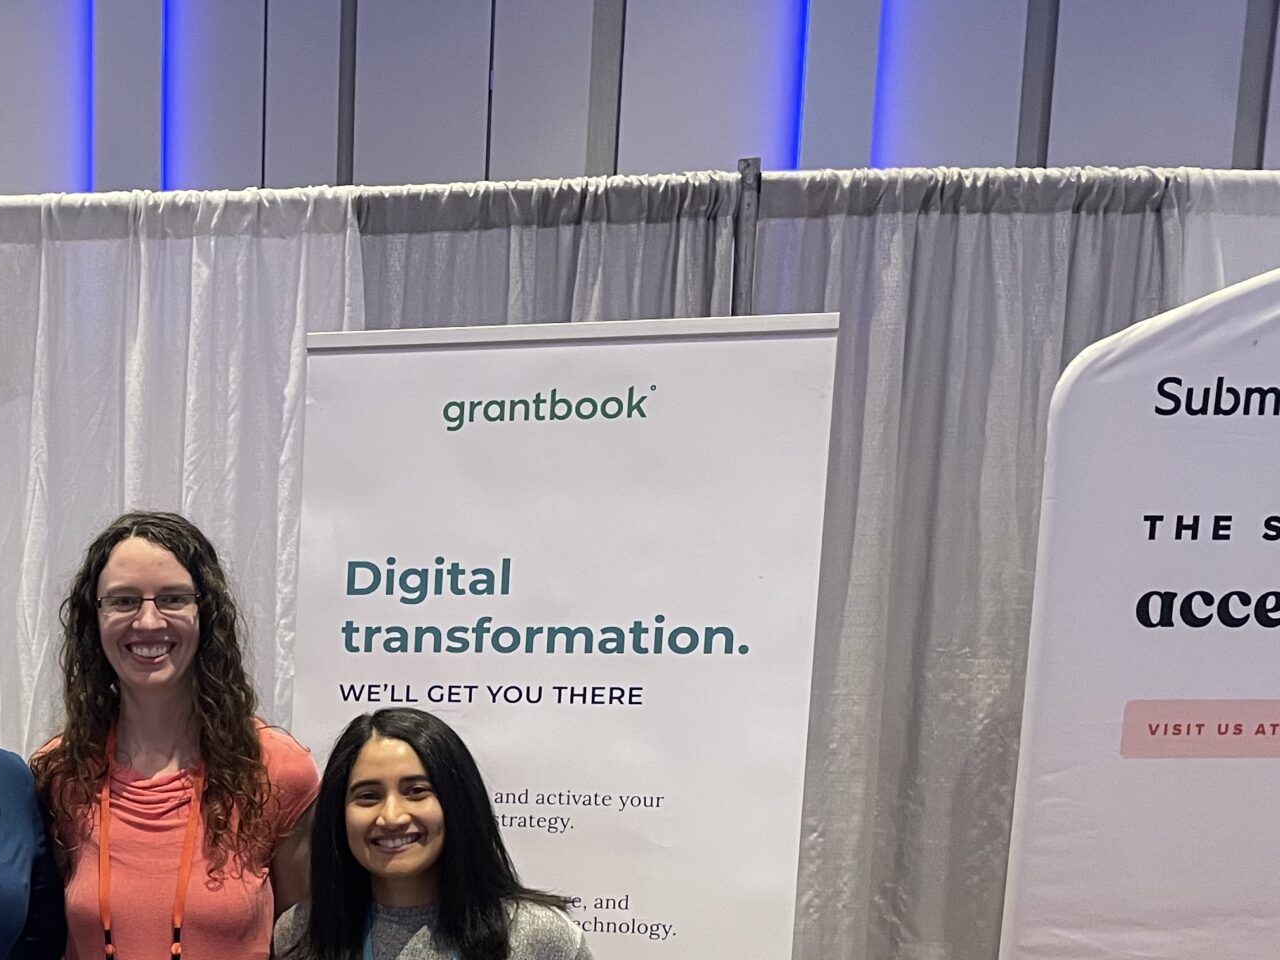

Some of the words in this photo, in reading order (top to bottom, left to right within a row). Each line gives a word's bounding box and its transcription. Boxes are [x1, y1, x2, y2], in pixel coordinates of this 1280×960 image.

[1143, 514, 1233, 540] THE
[346, 556, 512, 605] Digital
[342, 615, 751, 655] transformation.
[339, 683, 419, 703] WE'LL
[427, 684, 479, 704] GET
[487, 685, 543, 705] YOU
[553, 686, 644, 705] THERE
[1148, 723, 1205, 736] VISIT
[1217, 723, 1243, 736] US
[1254, 723, 1280, 736] AT
[494, 789, 529, 805] and
[535, 790, 612, 807] activate
[618, 794, 665, 812] your
[594, 895, 629, 910] and
